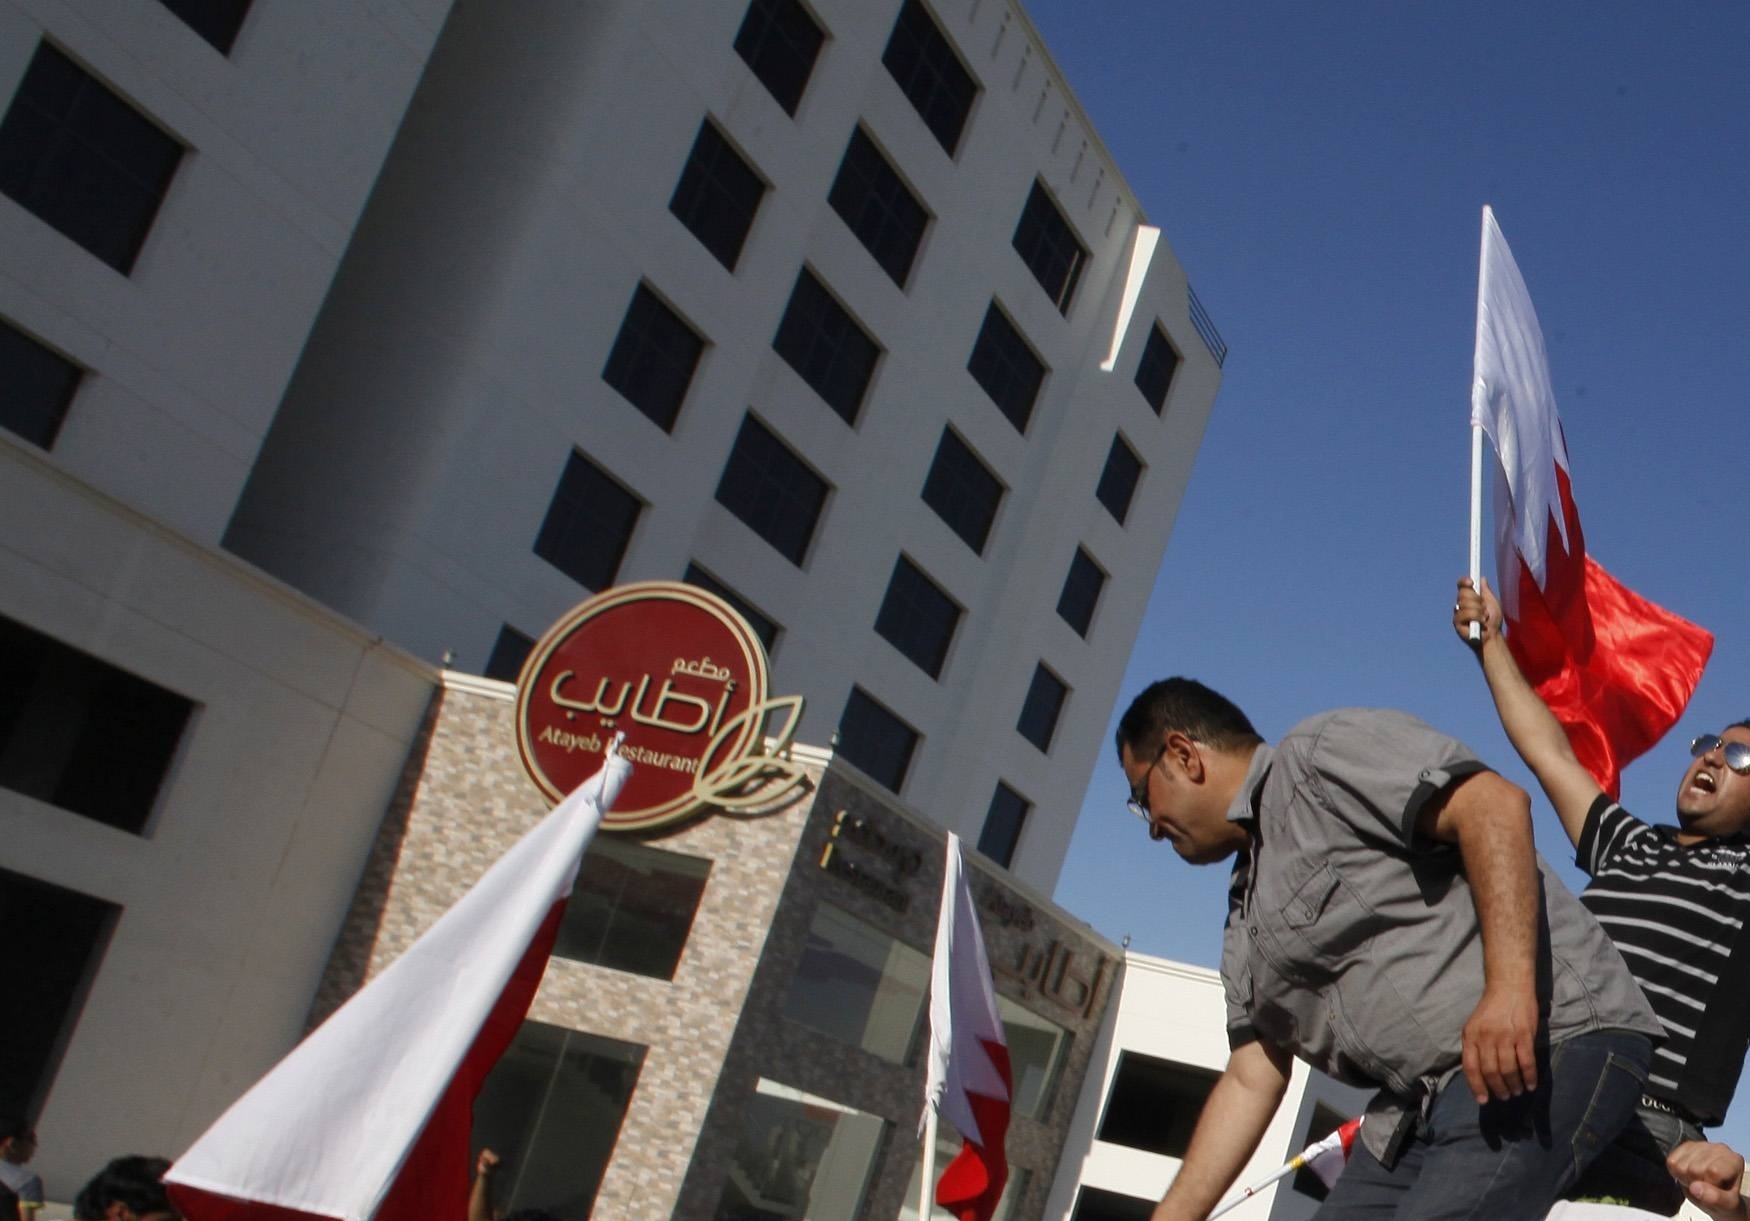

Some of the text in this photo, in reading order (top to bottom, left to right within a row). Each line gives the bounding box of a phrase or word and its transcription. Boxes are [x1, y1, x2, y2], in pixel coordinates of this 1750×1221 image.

[671, 656, 731, 681] مطعم
[550, 669, 736, 738] أطايب
[538, 725, 701, 775] Atayeb estaurant
